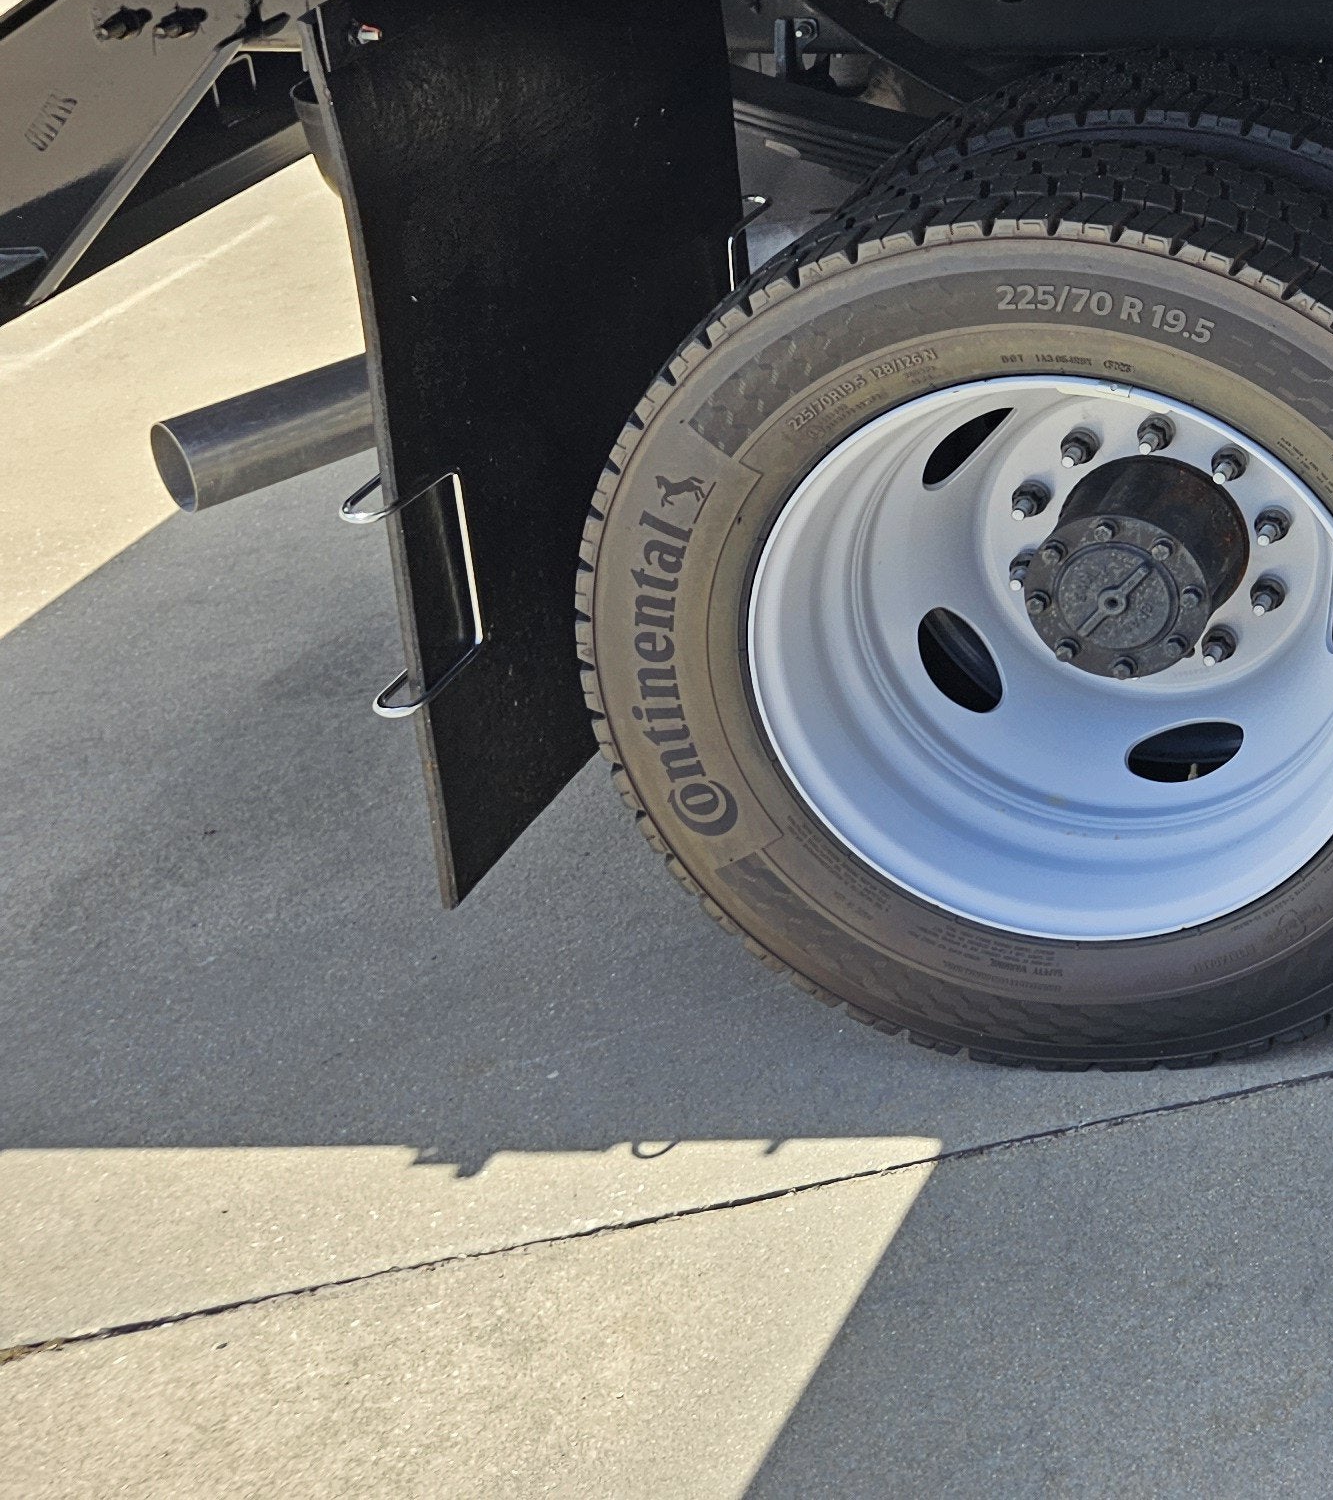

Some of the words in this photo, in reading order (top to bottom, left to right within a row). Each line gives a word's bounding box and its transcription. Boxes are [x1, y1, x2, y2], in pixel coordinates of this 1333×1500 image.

[996, 284, 1114, 316] 225/70
[1119, 296, 1144, 324] R
[1151, 304, 1216, 344] 19.5
[631, 509, 739, 837] Continental
